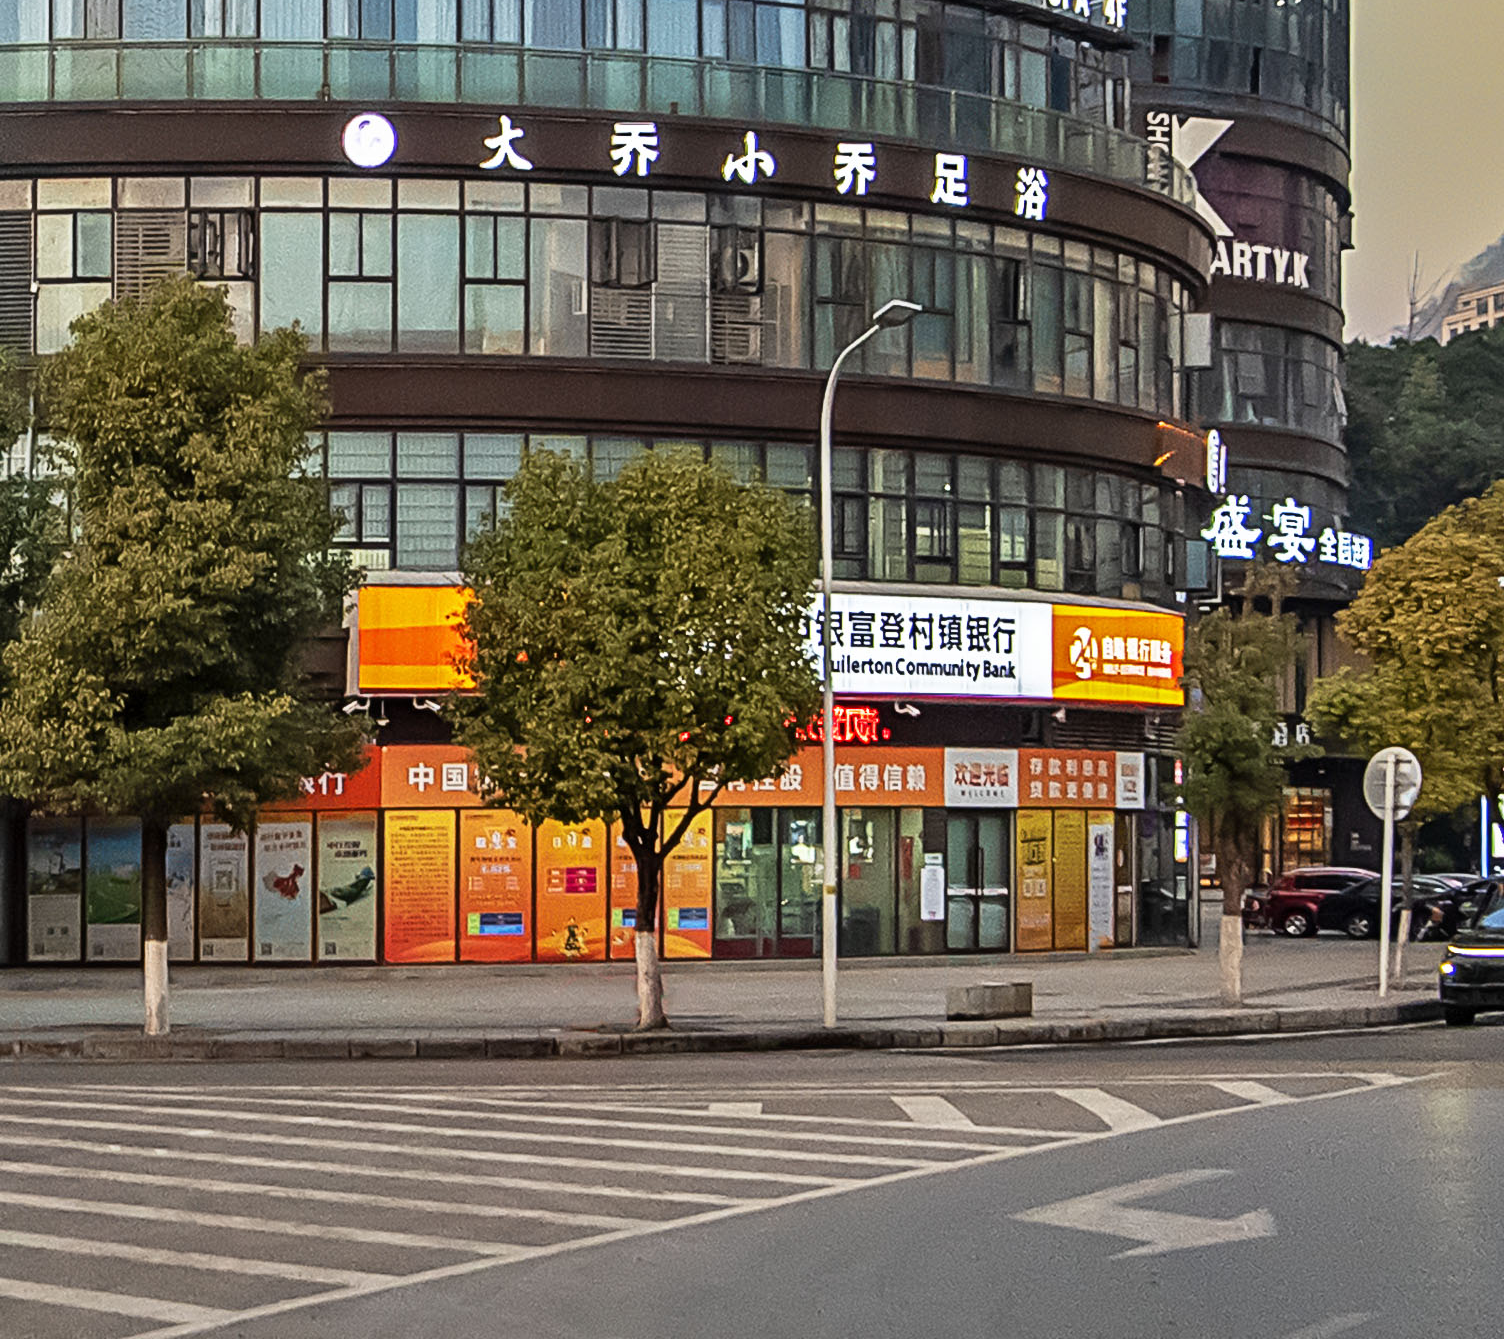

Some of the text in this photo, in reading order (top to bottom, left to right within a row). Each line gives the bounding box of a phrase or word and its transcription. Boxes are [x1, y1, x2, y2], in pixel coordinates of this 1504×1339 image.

[479, 115, 1050, 222] 大乔小乔足浴
[1210, 239, 1309, 289] ARTY.K
[896, 658, 979, 681] Community
[983, 661, 1016, 680] Bank
[835, 764, 926, 791] 值得信赖
[954, 762, 1009, 787] 欢迎光临
